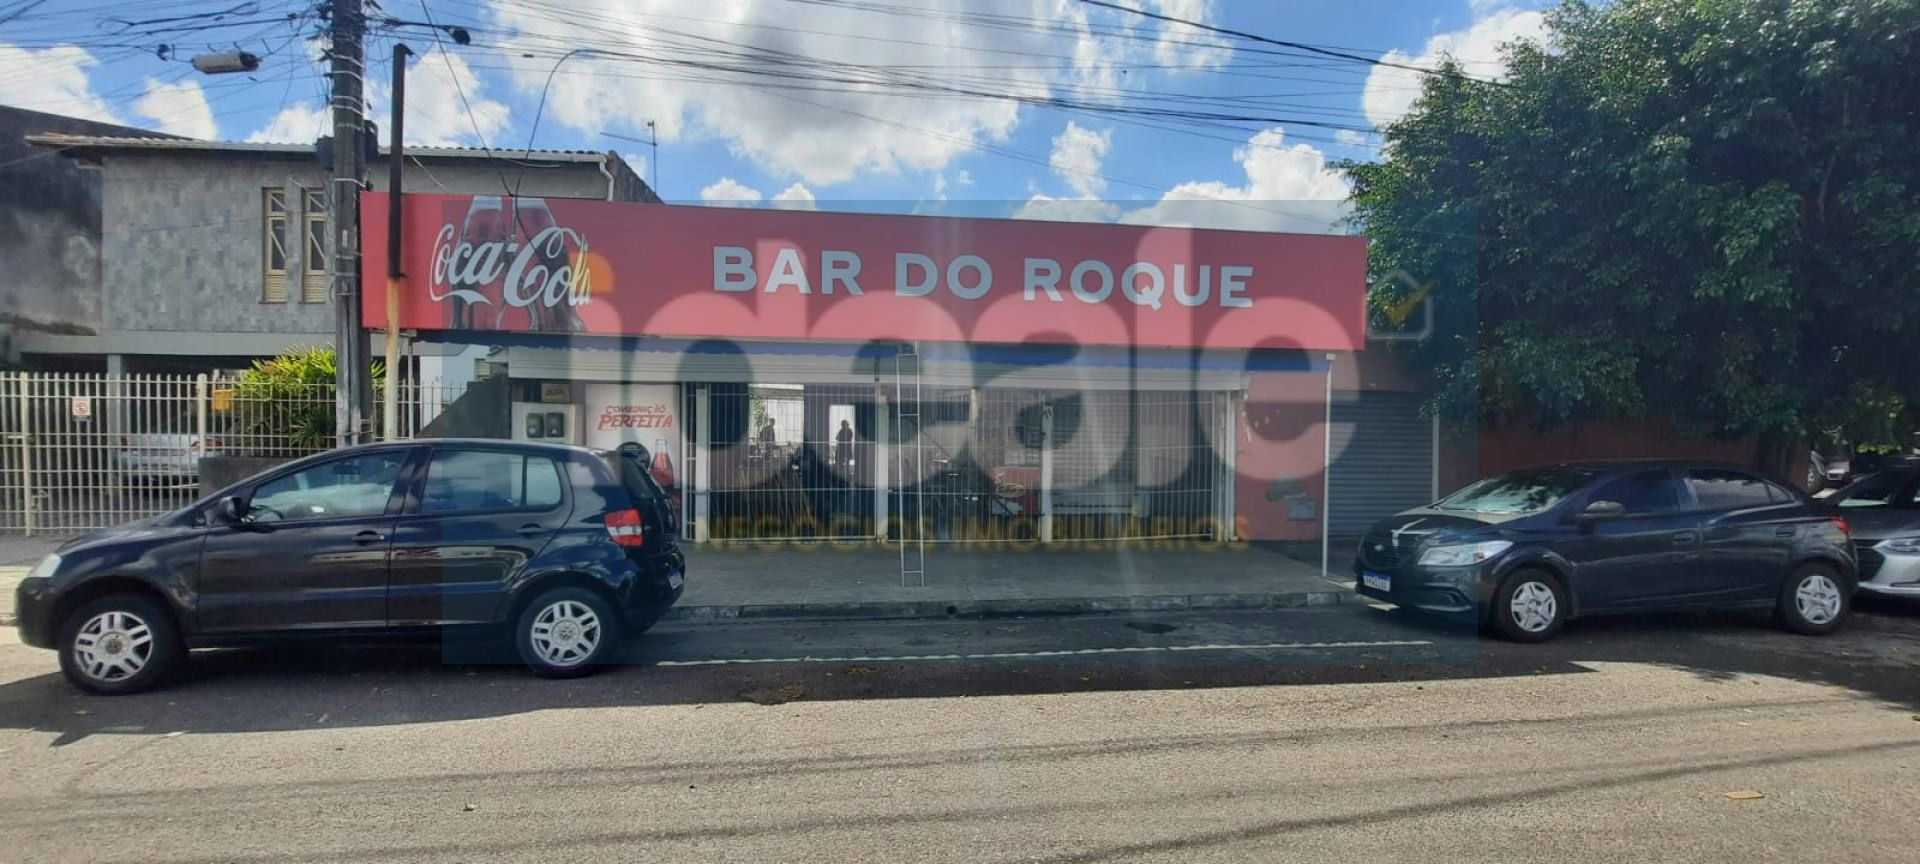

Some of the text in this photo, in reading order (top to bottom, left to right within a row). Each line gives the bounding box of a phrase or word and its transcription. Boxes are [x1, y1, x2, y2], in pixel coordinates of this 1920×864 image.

[430, 223, 591, 307] Coca-Cola
[713, 246, 1254, 310] BAR DO ROQUE
[598, 414, 673, 431] PERFEITA
